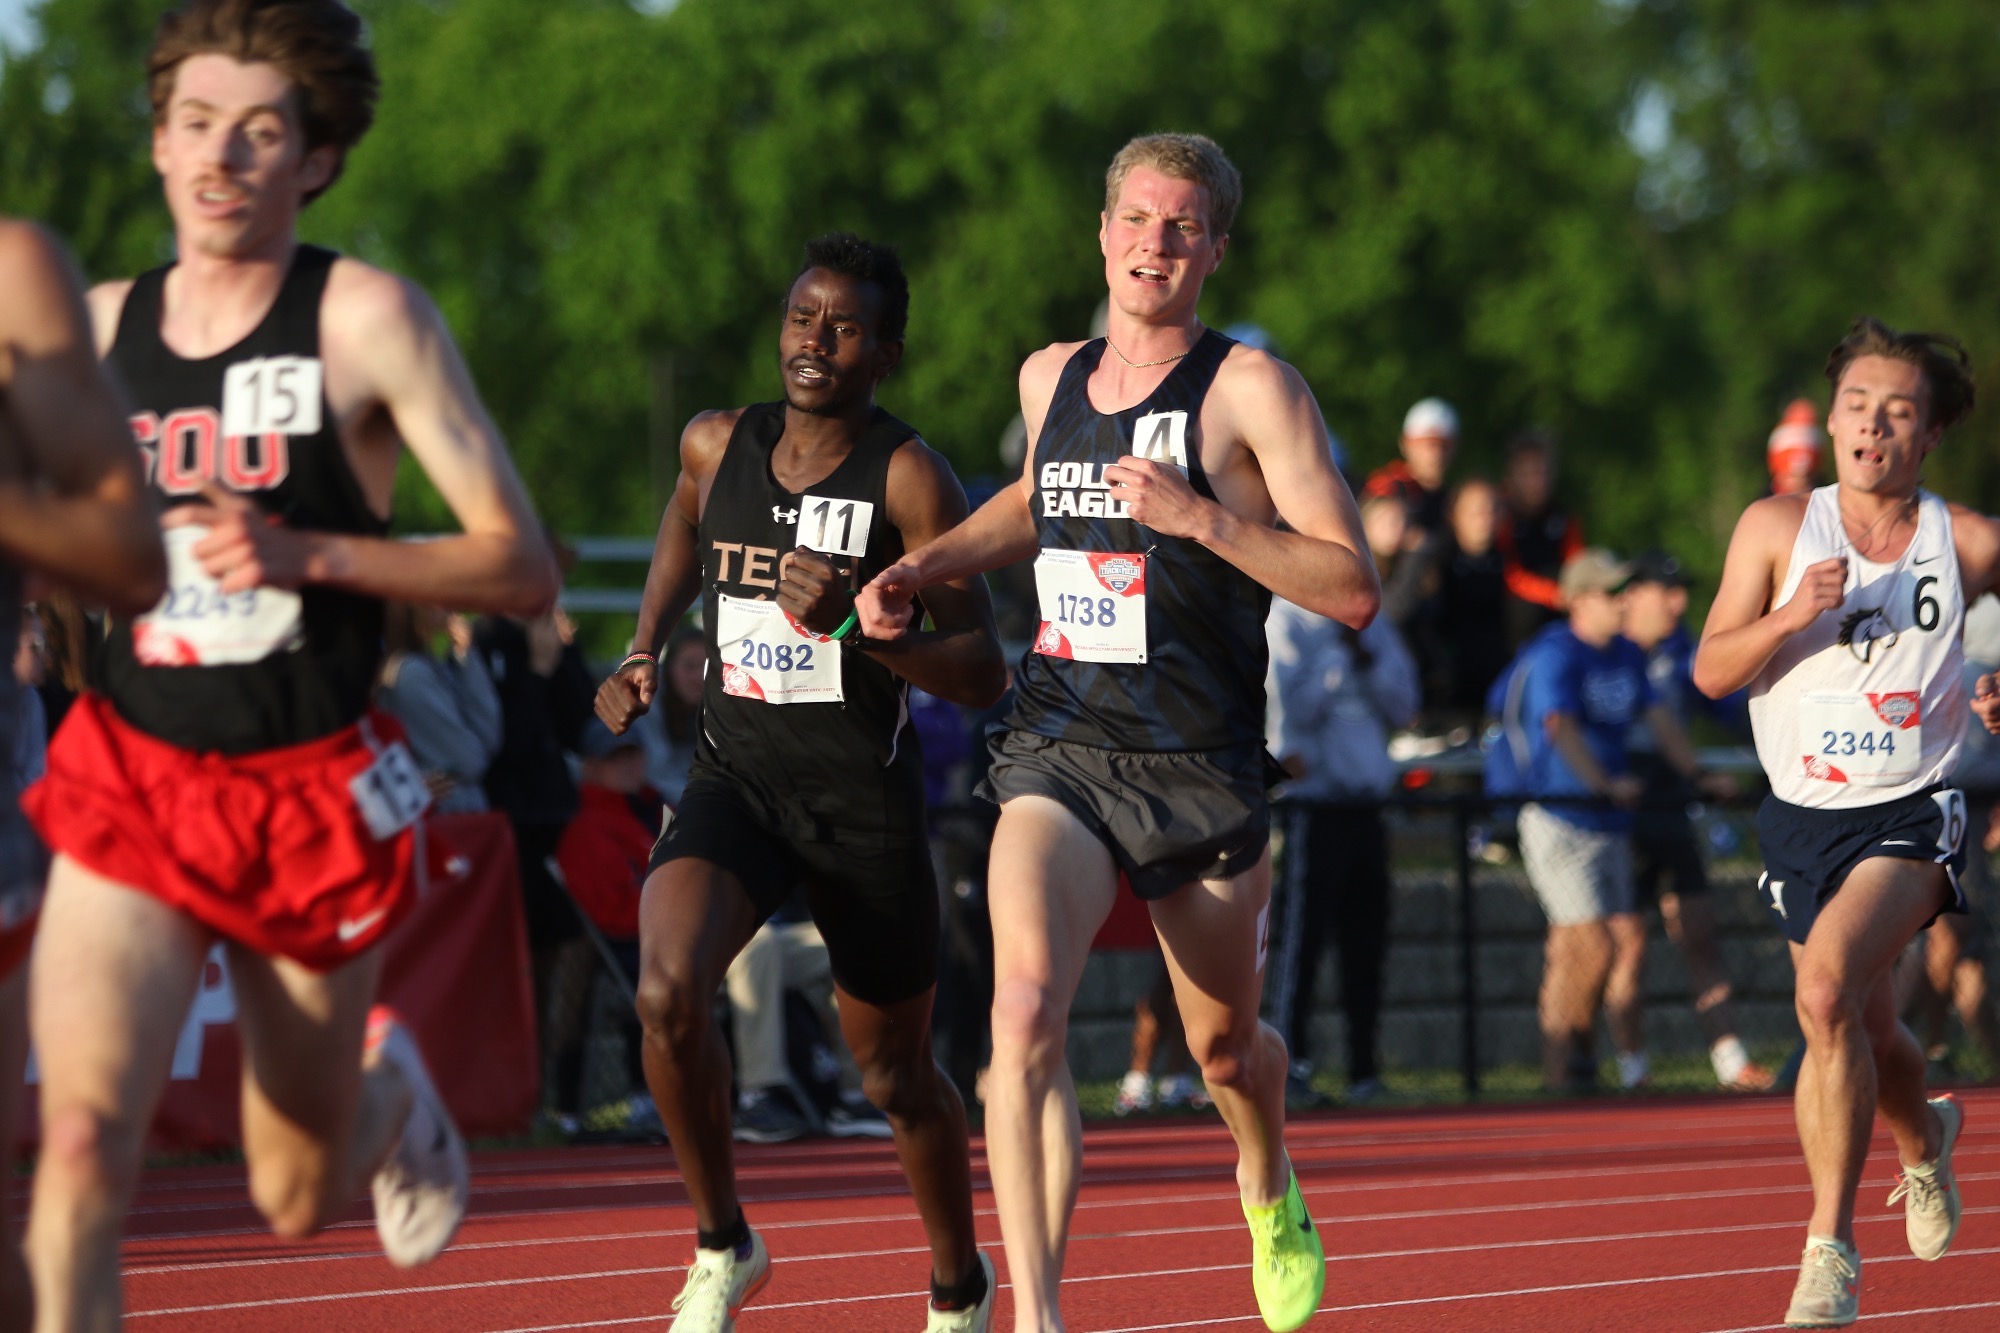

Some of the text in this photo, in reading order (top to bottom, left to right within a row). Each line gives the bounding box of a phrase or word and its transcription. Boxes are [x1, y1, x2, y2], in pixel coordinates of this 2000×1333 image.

[243, 366, 299, 427] 15
[1144, 417, 1178, 465] 4
[813, 500, 856, 552] 11
[1058, 593, 1117, 628] 1738
[1913, 576, 1940, 632] 6
[740, 639, 815, 673] 2082
[1822, 731, 1896, 756] 2344
